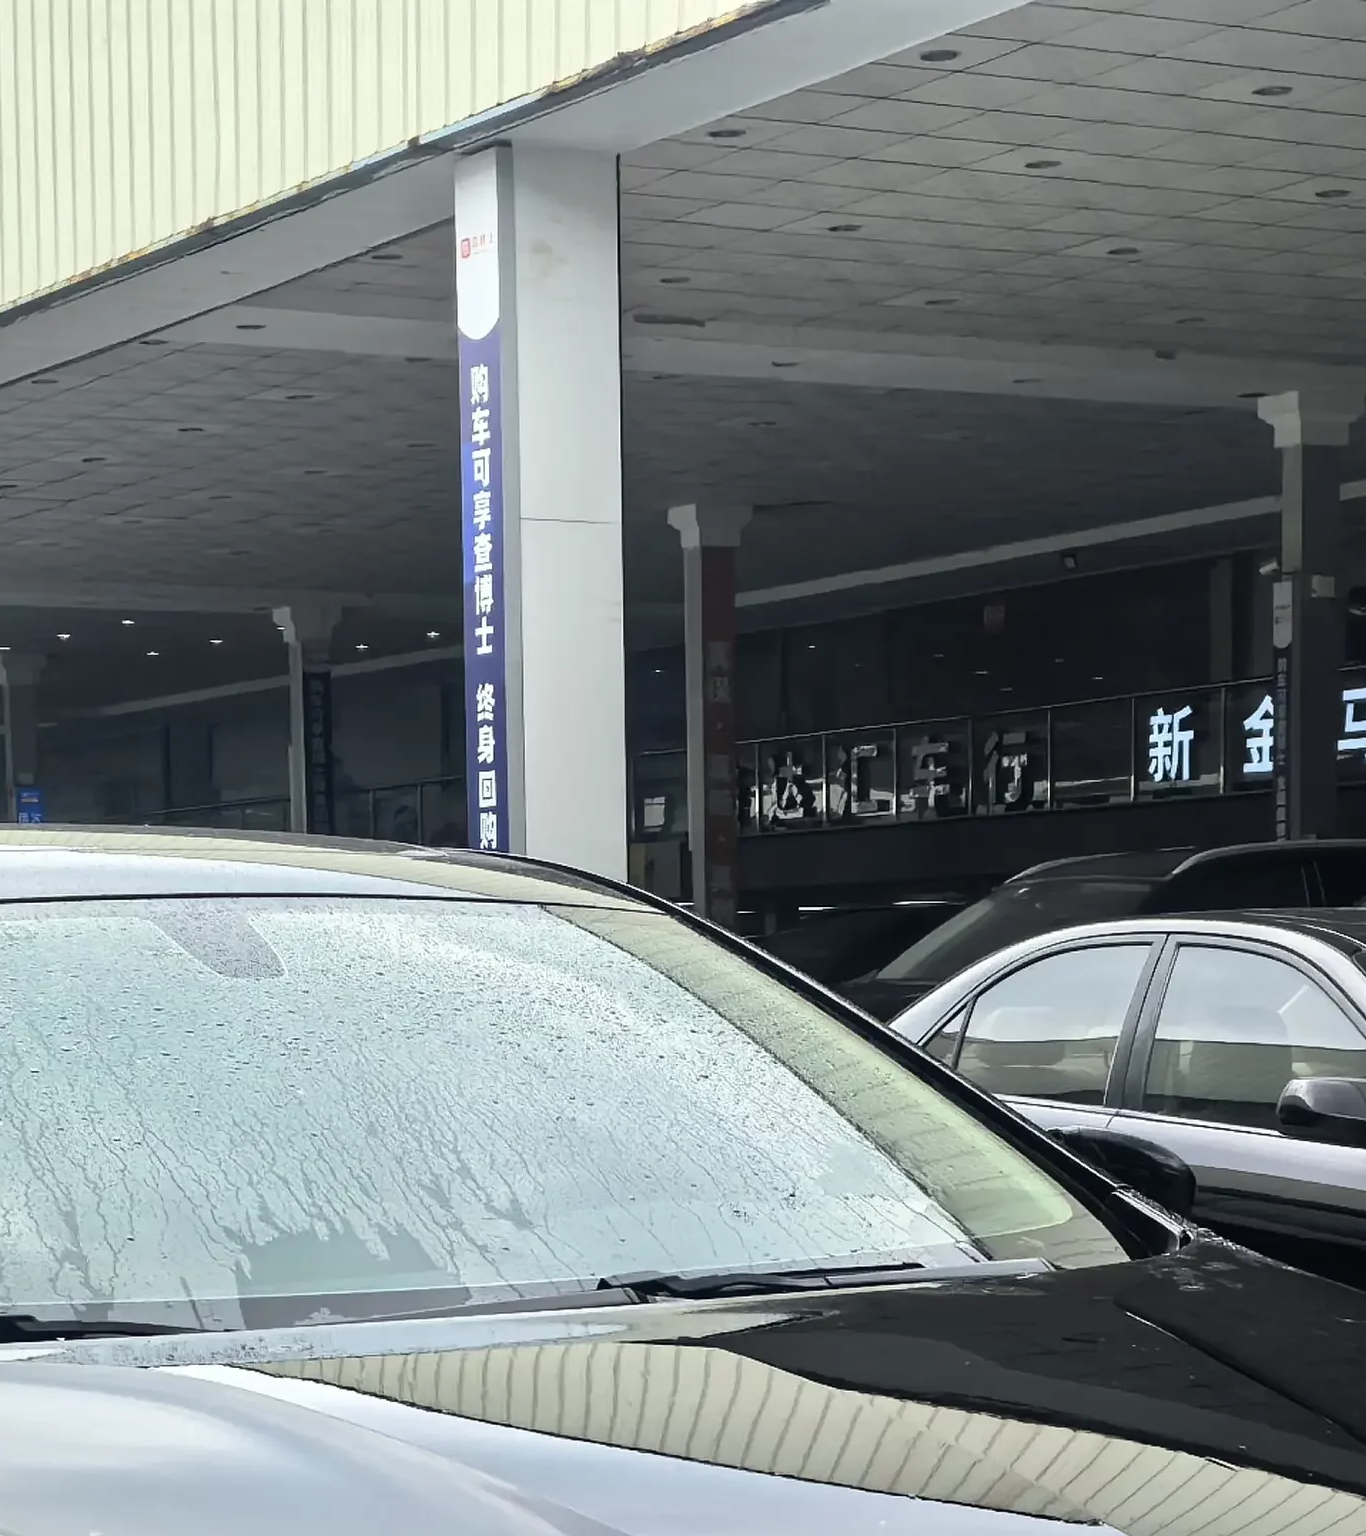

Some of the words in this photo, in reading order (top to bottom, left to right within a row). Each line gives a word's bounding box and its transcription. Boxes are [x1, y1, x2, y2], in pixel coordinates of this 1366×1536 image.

[469, 362, 495, 658] 购车可享查博士
[474, 682, 499, 850] 终身回购
